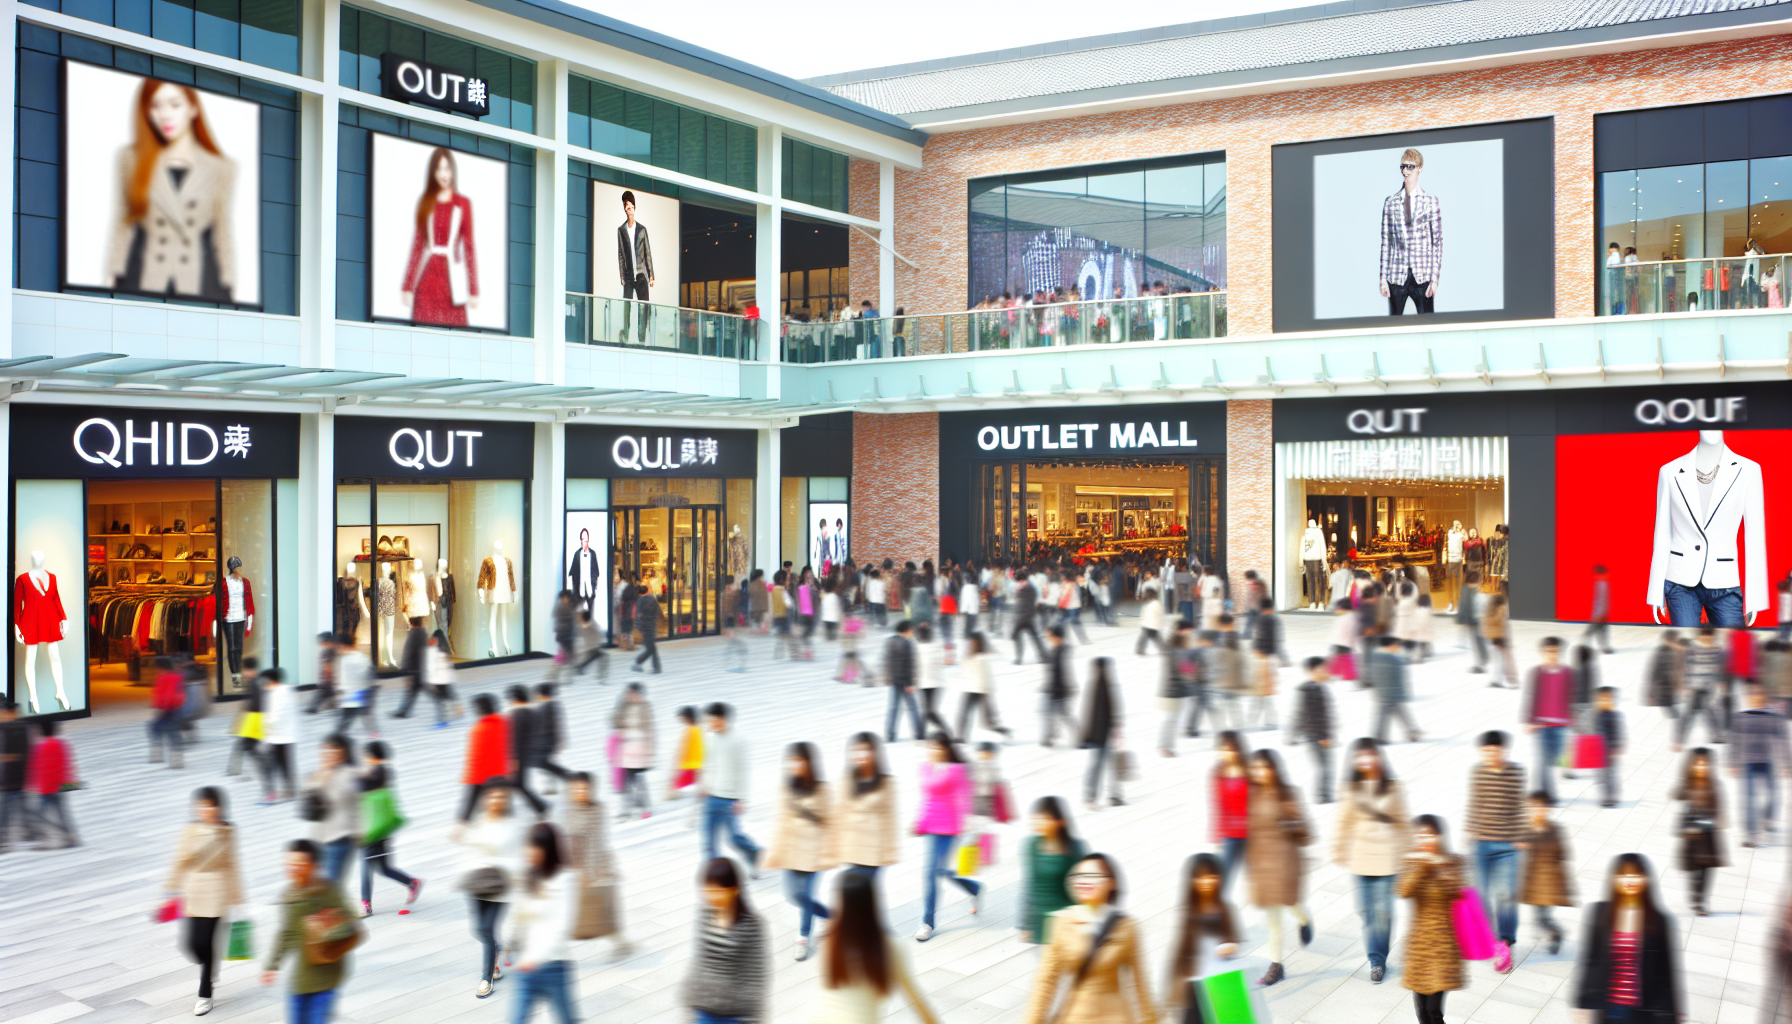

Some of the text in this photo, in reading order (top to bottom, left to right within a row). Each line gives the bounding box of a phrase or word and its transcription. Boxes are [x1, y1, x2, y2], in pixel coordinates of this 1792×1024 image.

[397, 61, 466, 103] OUT
[977, 420, 1198, 450] OUTLET MALL
[1346, 408, 1428, 434] QUT
[73, 417, 219, 468] QHID
[388, 427, 483, 470] QUT
